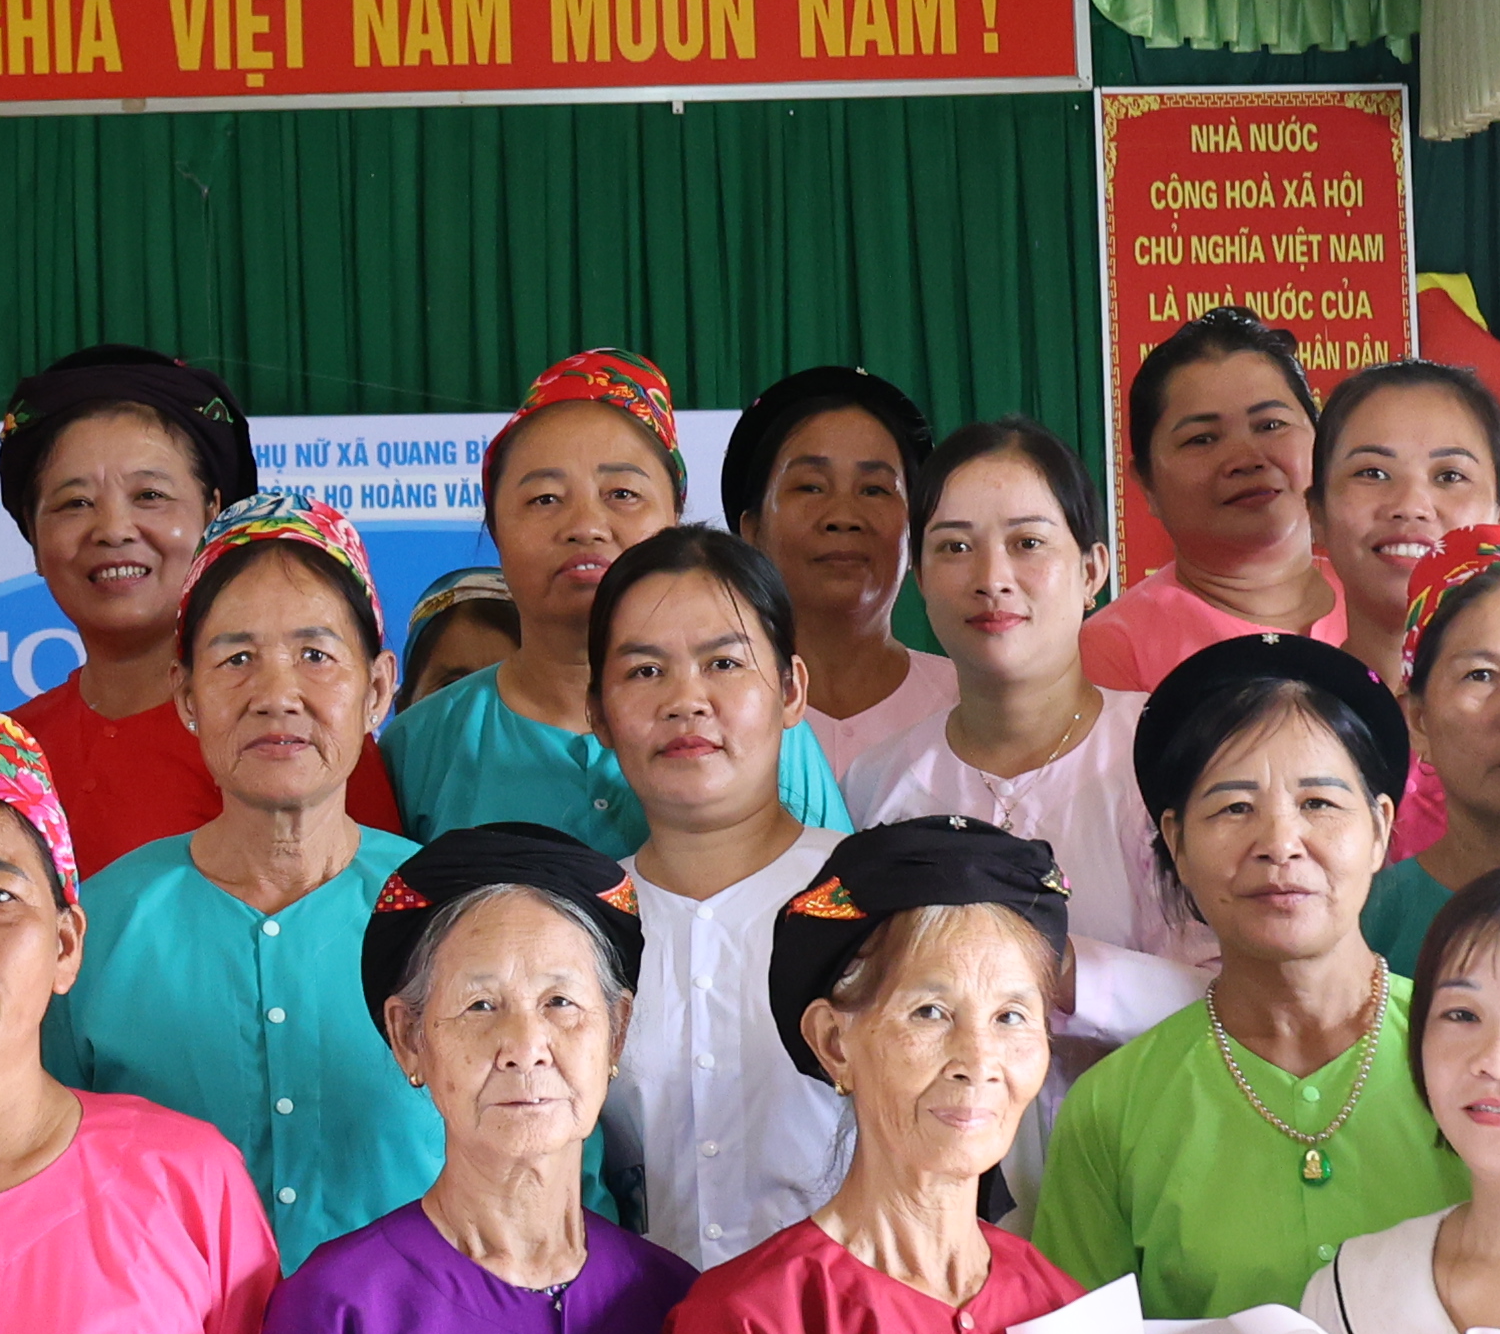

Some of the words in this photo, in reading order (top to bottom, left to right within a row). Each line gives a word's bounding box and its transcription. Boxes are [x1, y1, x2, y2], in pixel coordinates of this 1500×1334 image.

[1190, 117, 1244, 153] NHÀ
[1249, 116, 1319, 153] NƯỚC
[1150, 172, 1218, 218] CỘNG
[1225, 172, 1276, 209] HOÀ
[1282, 171, 1318, 208] XÃ
[1323, 170, 1364, 216] HỘI
[1134, 223, 1184, 266] CHỦ
[1190, 226, 1266, 265] NGHĨA
[1271, 226, 1323, 271] VIỆT
[1329, 233, 1385, 263] NAM
[1148, 284, 1181, 322] LÀ
[1244, 282, 1315, 321] NƯỚC
[1320, 278, 1374, 320] CỦA
[1294, 334, 1341, 371] HÂN
[1345, 333, 1390, 371] DÂN
[254, 443, 287, 474] HỤ
[295, 438, 332, 468] NỮ
[337, 437, 369, 467] XÃ
[376, 440, 457, 469] QUANG
[324, 484, 353, 515] HỌ
[361, 478, 437, 509] HOÀNG
